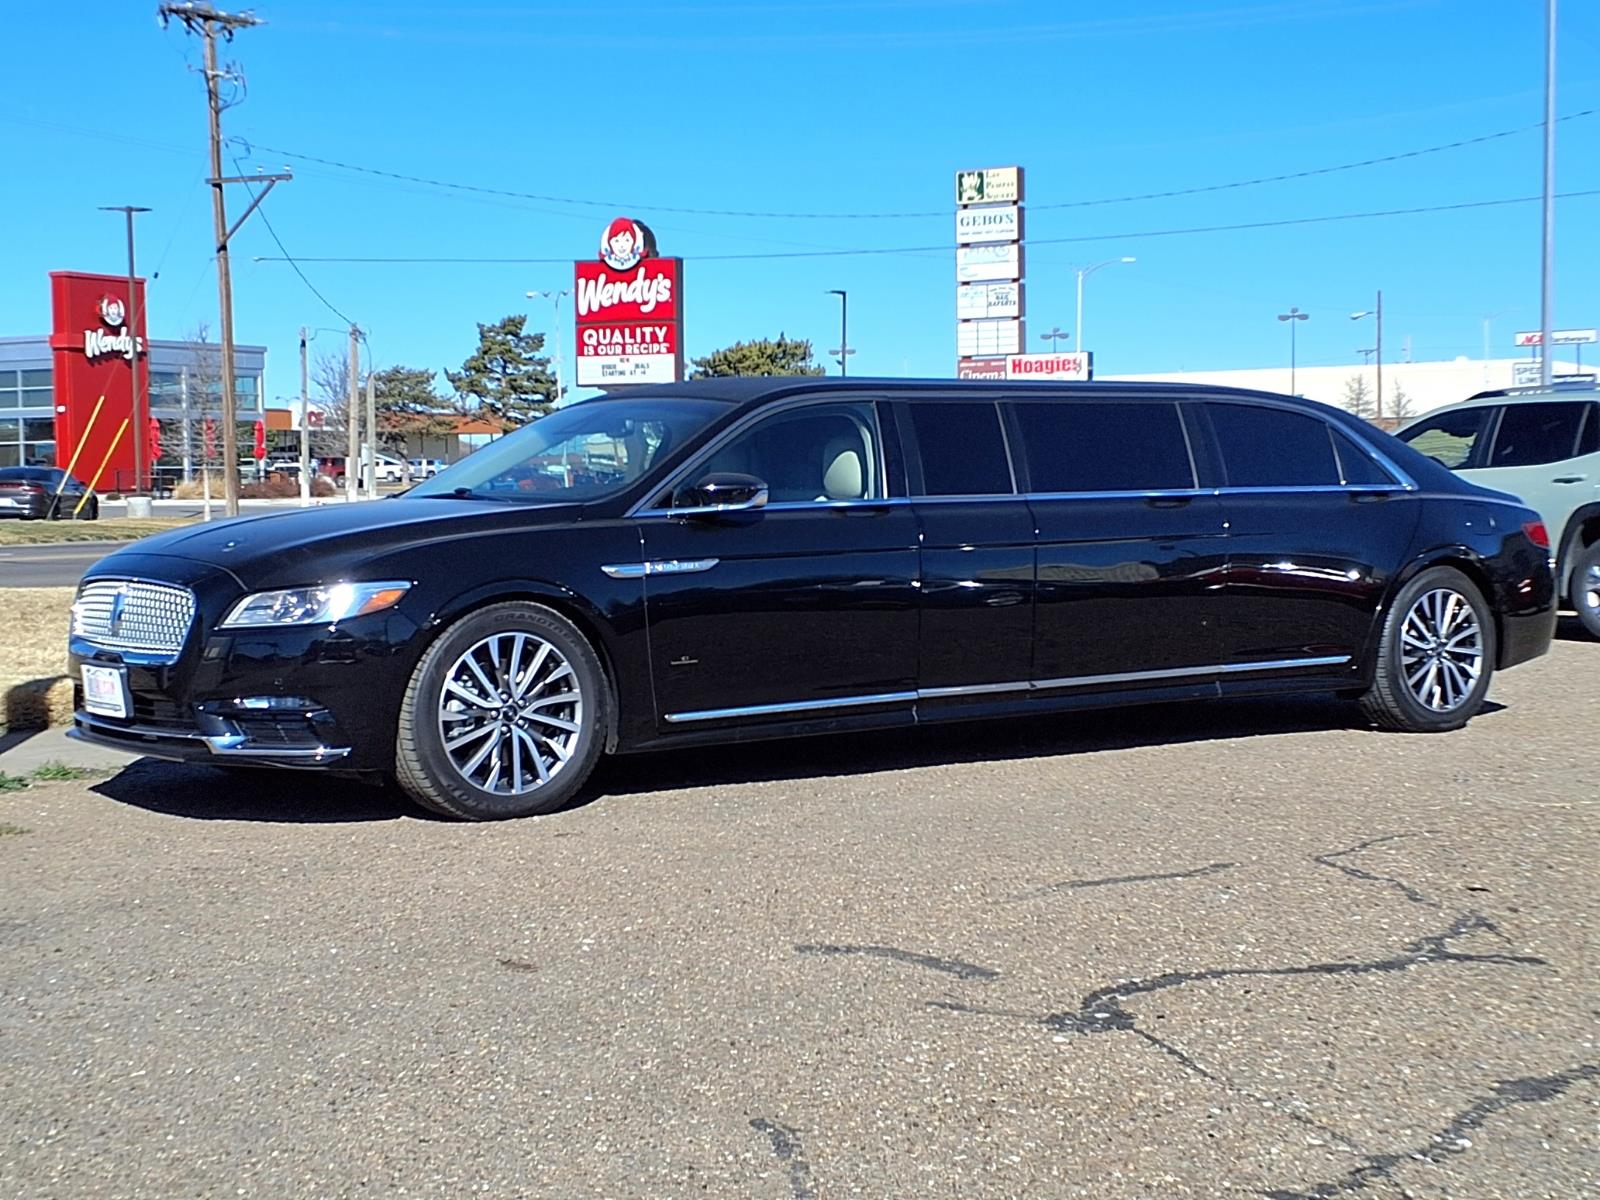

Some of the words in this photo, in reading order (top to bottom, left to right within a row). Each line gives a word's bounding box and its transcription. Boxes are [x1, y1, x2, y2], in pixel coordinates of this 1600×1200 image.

[578, 267, 672, 316] Wendy's
[84, 326, 143, 360] Wendys
[583, 326, 667, 345] QUALITY
[584, 345, 595, 356] IS
[597, 344, 623, 355] OUR
[625, 343, 668, 354] RECIPE
[1012, 356, 1082, 375] Hoagies
